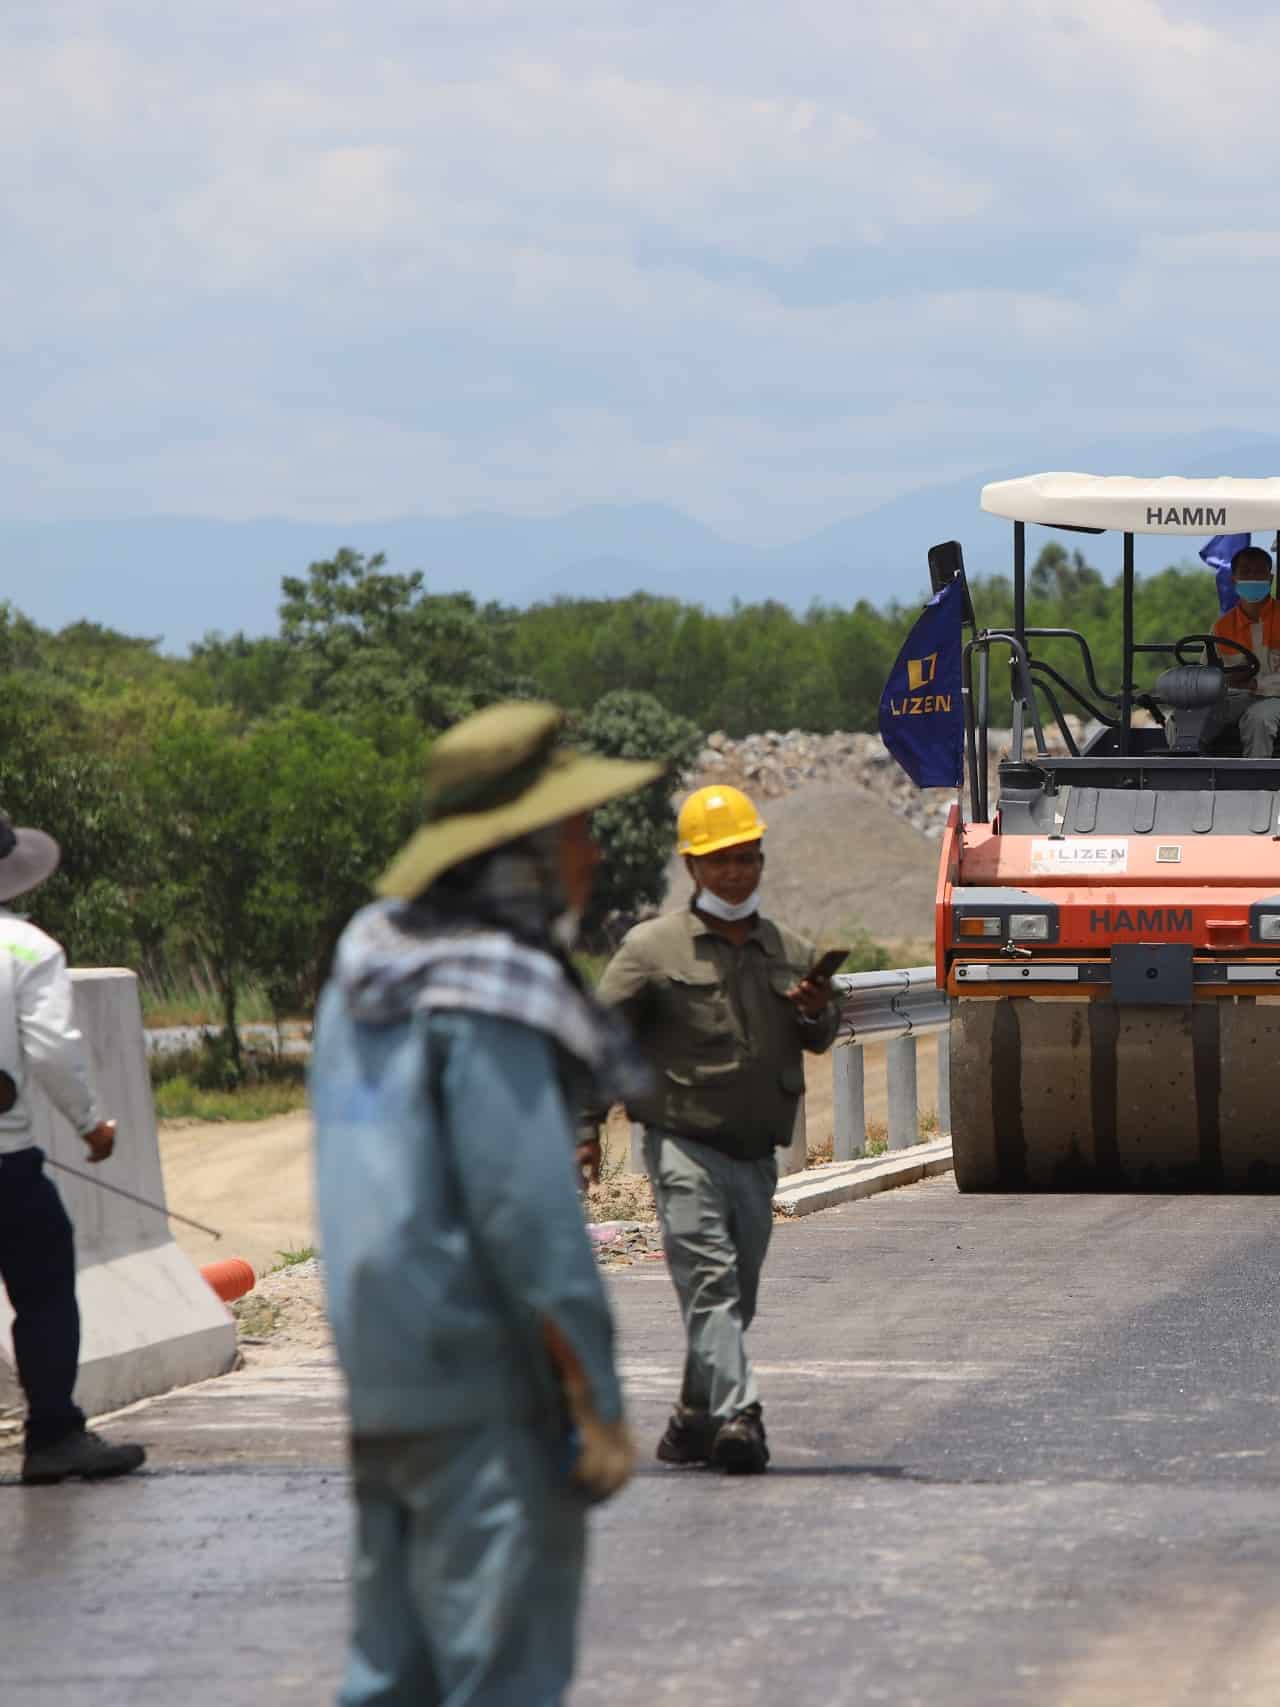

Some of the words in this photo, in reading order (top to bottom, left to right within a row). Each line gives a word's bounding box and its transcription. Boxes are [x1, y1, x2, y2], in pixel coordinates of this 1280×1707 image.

[1146, 507, 1226, 526] HAMM
[890, 694, 951, 716] LIZEN
[1058, 849, 1126, 860] LIZEN
[1090, 909, 1192, 933] HAMM
